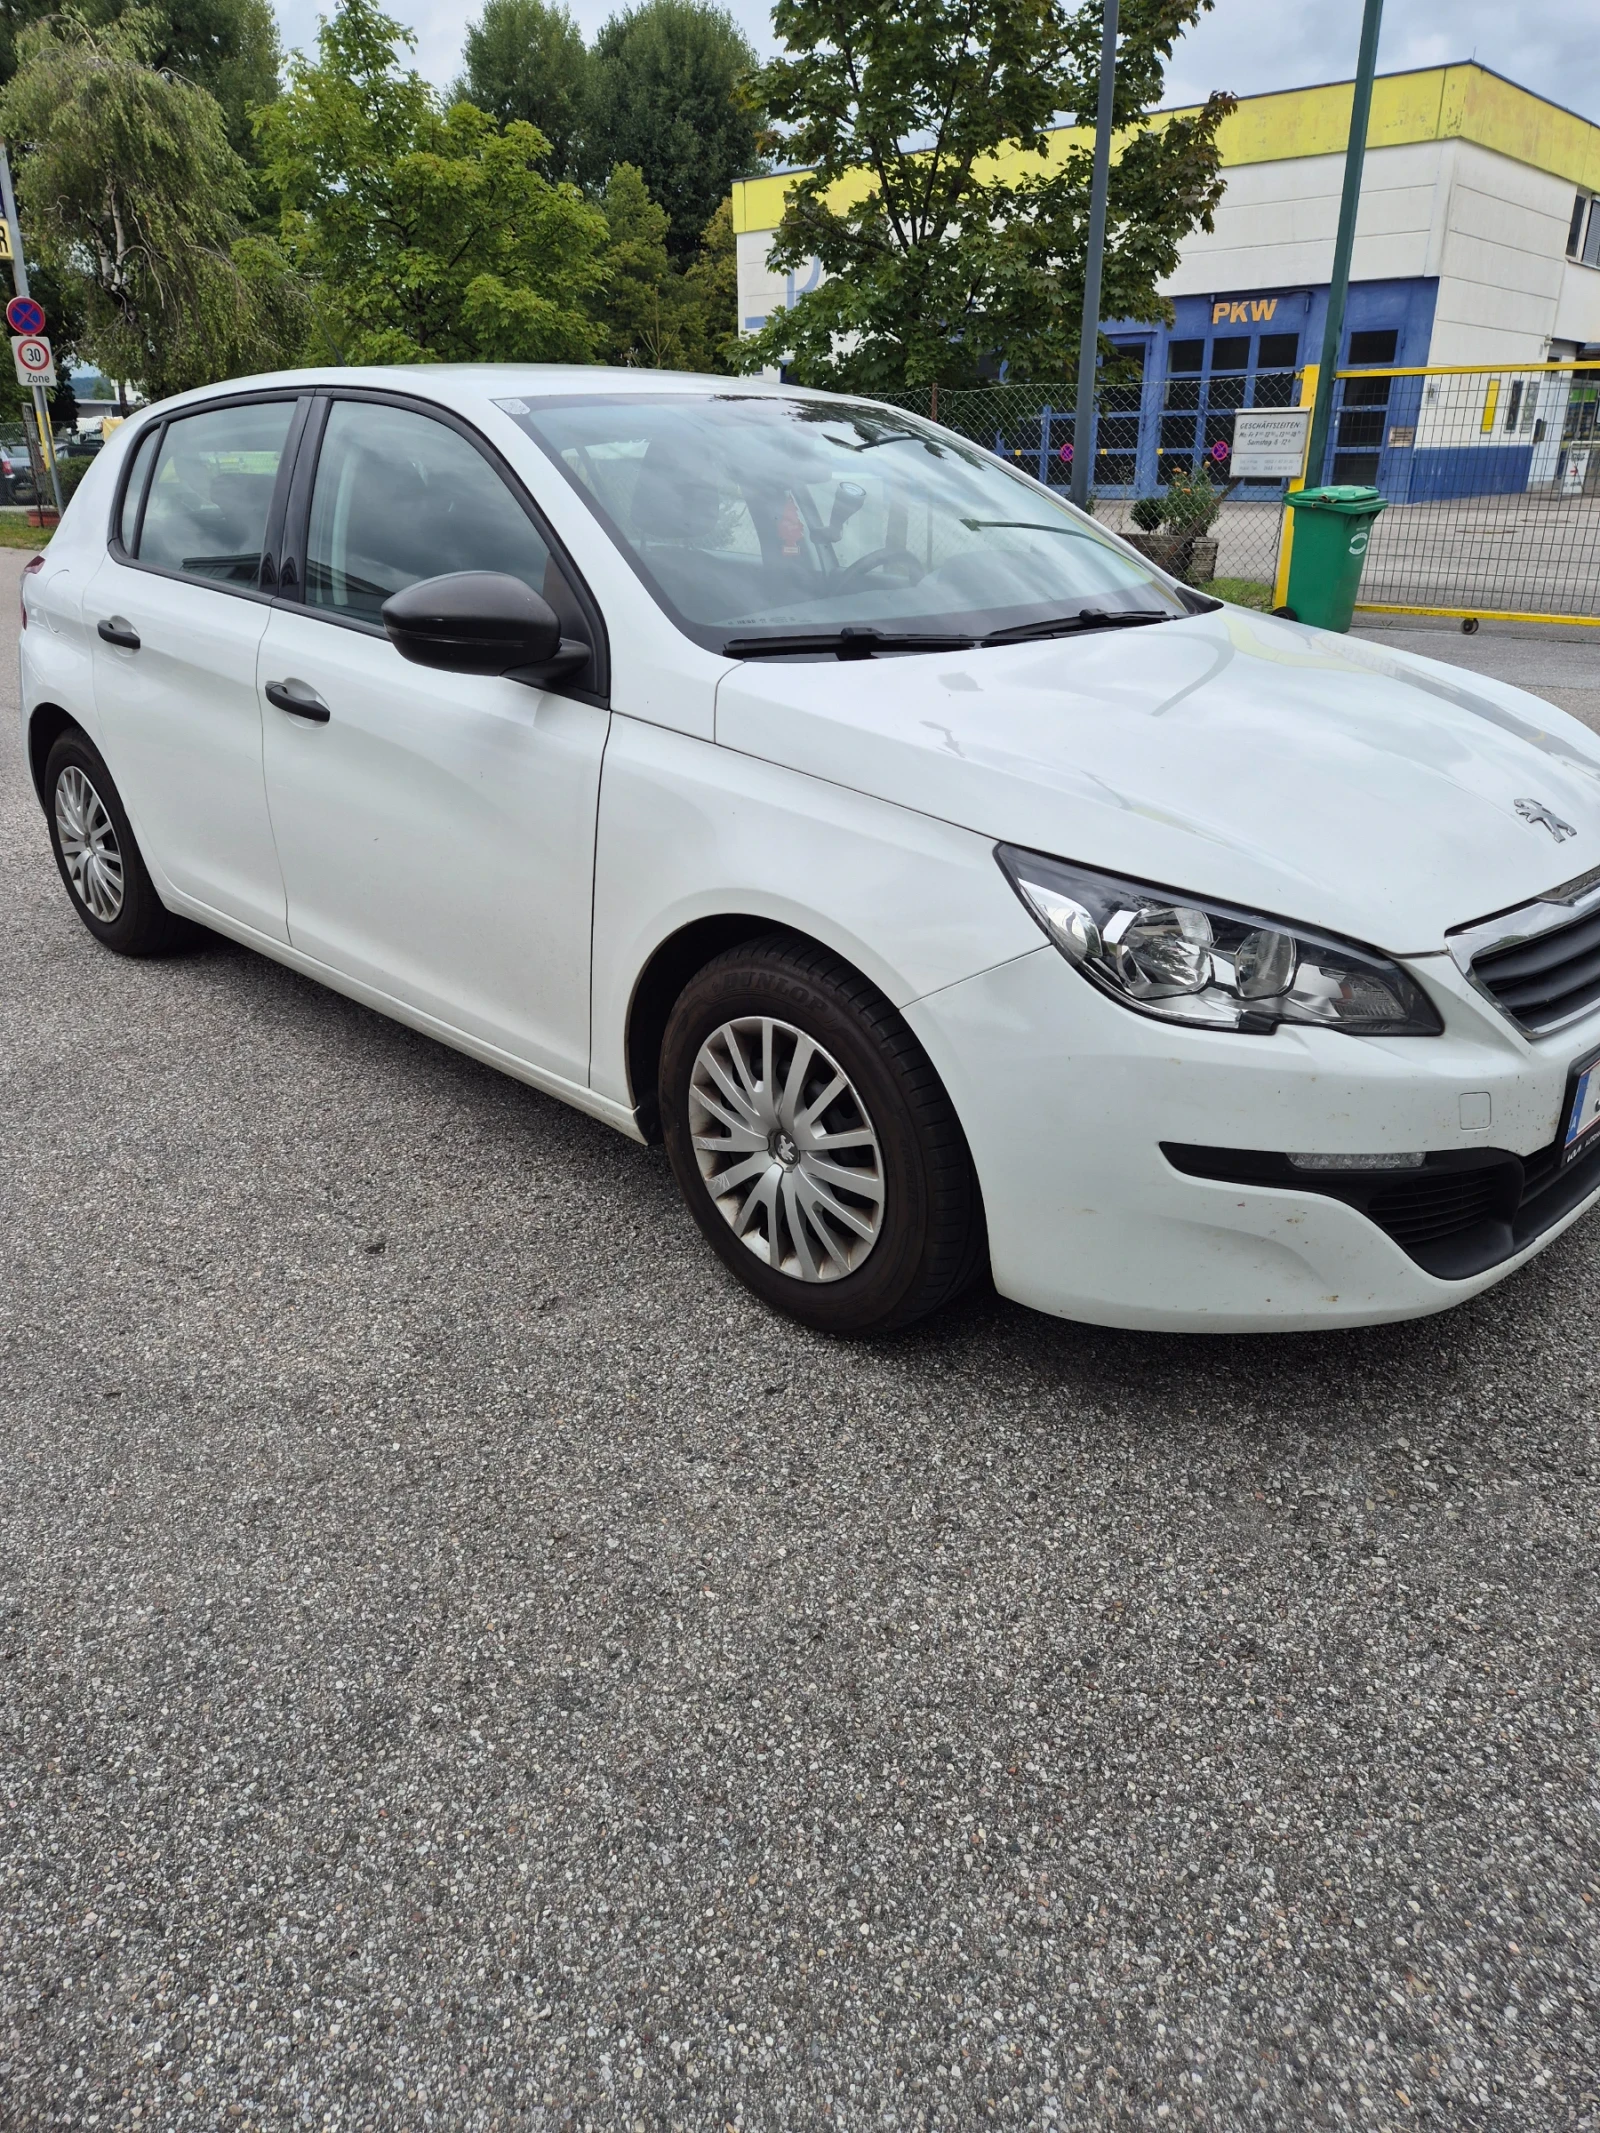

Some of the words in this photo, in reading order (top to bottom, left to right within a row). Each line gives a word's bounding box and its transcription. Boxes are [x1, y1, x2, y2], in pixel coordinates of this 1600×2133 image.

[1212, 298, 1279, 325] PKW
[26, 347, 42, 362] 30
[25, 372, 50, 383] Zone
[723, 971, 829, 1012] DUNLOP
